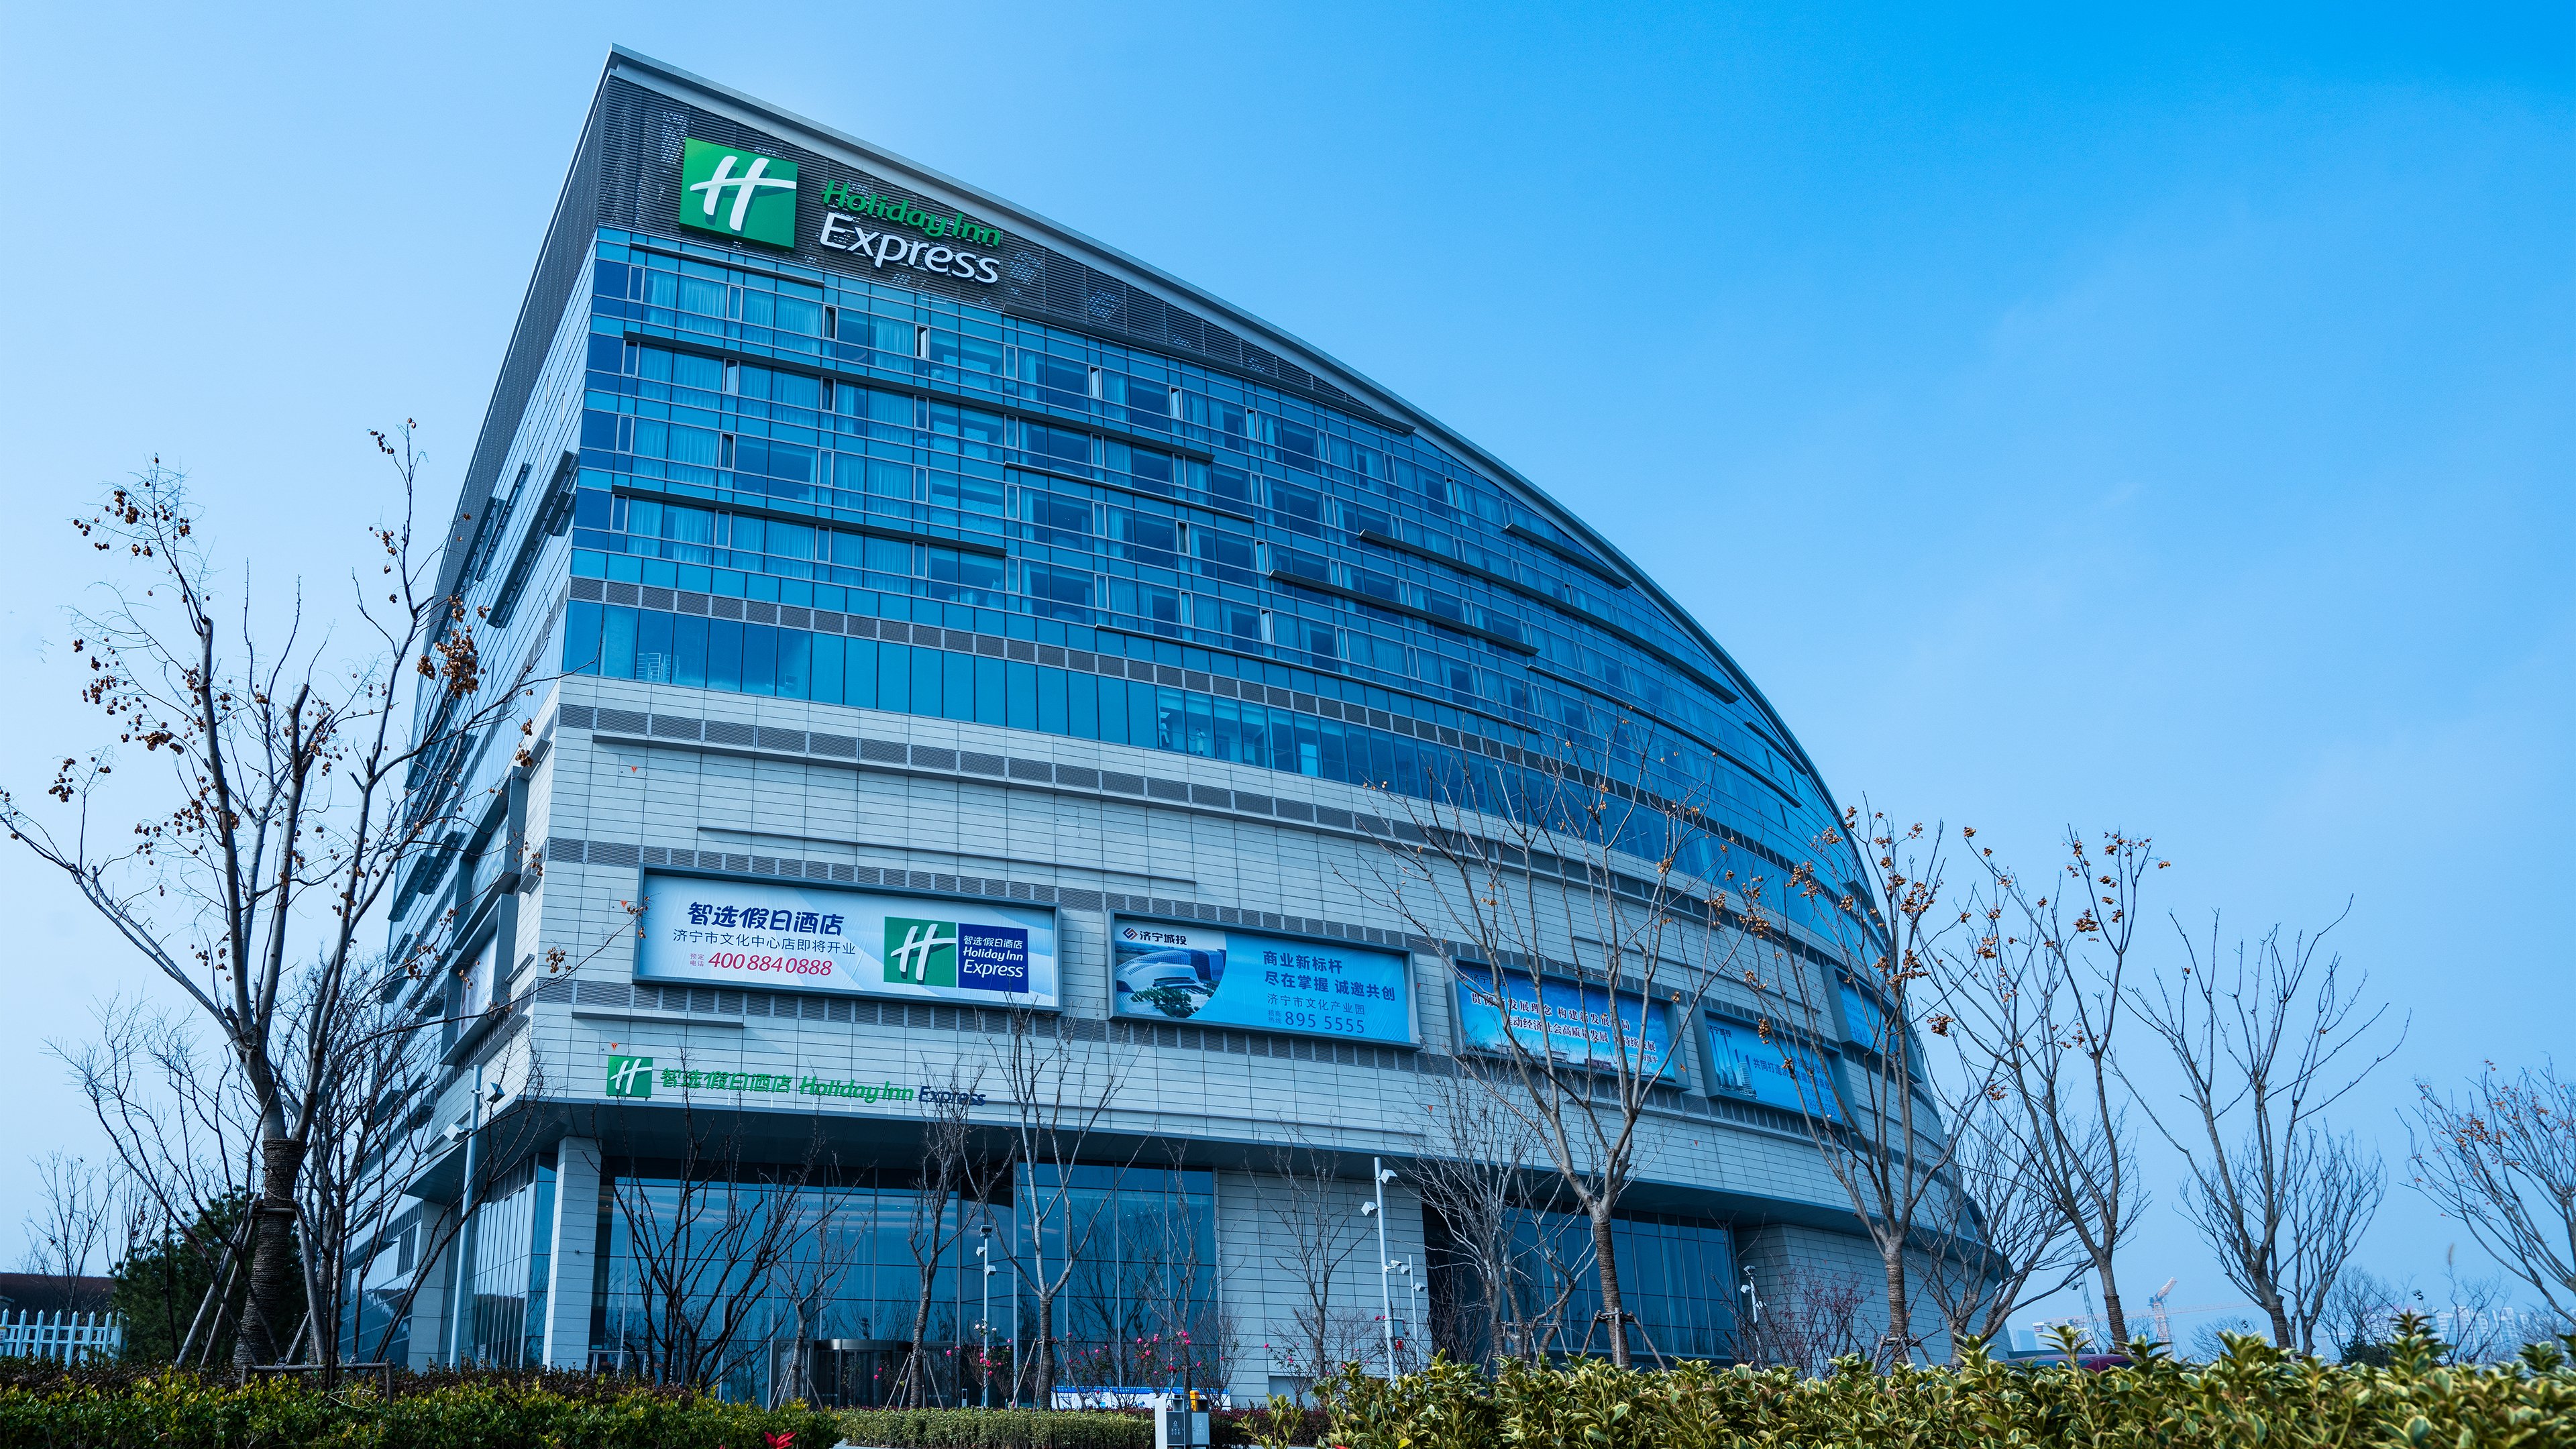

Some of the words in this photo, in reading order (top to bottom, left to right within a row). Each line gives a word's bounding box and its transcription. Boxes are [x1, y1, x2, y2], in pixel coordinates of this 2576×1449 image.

[821, 180, 947, 239] Holiday
[952, 212, 1002, 248] Inn
[820, 211, 1000, 285] Express
[688, 902, 845, 936] 智选假日酒店
[673, 929, 855, 955] 济宁市文化中心店即将开业
[963, 935, 1023, 949] 智选假日酒店
[1140, 931, 1187, 945] 济宁城投
[708, 952, 745, 969] 400
[747, 955, 784, 972] 884
[786, 958, 833, 975] 0888
[963, 946, 1006, 962] Holiday
[1006, 950, 1023, 961] Inn
[1263, 951, 1342, 974] 商业新标杆
[963, 959, 1024, 978] Express
[1265, 971, 1329, 992] 尽在掌握
[1335, 979, 1395, 1002] 诚邀共创
[1267, 993, 1365, 1016] 济宁市文化产业园
[1285, 1011, 1316, 1028] 895
[1324, 1016, 1364, 1034] 5555
[660, 1067, 793, 1093] 智选假日酒店
[799, 1075, 879, 1104] Holiday
[881, 1081, 914, 1102] Inn
